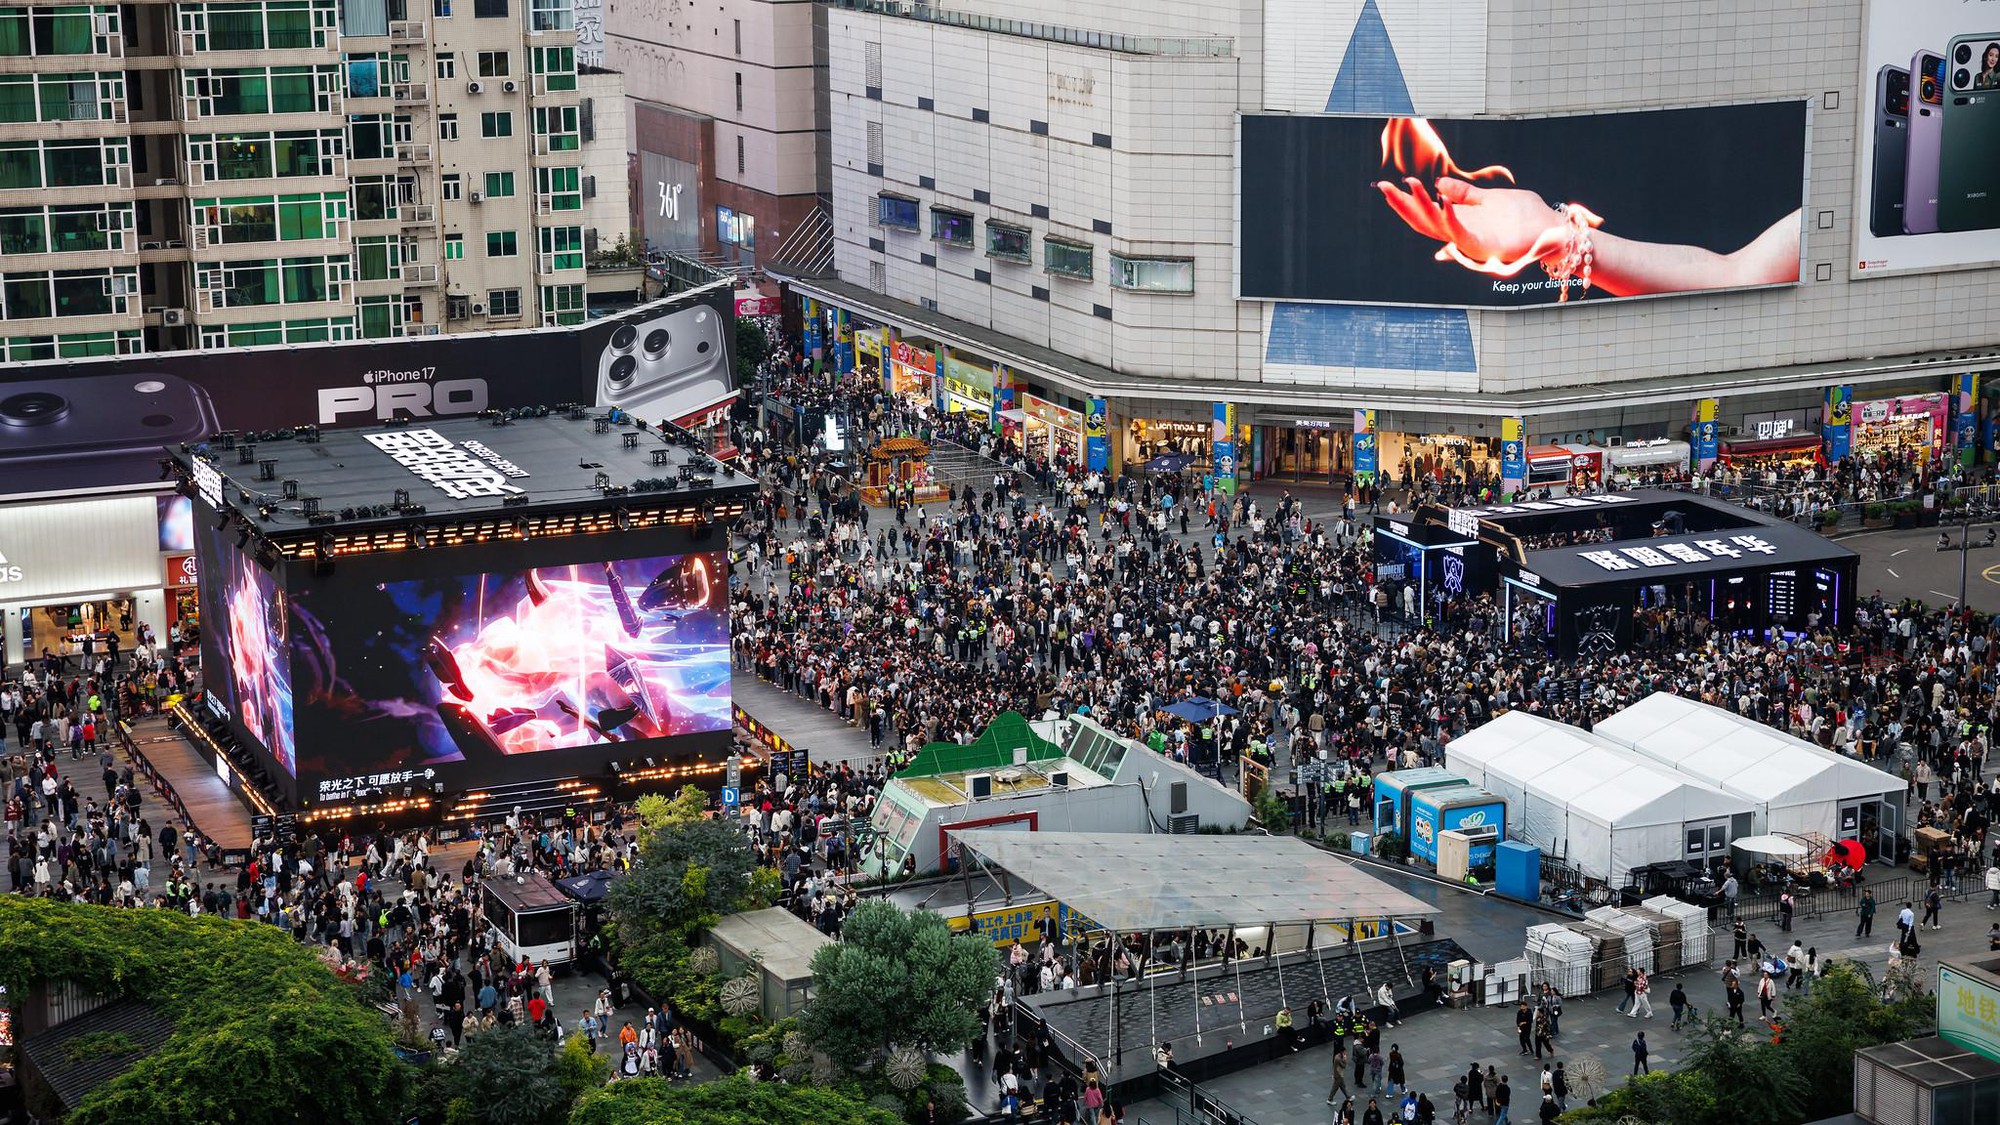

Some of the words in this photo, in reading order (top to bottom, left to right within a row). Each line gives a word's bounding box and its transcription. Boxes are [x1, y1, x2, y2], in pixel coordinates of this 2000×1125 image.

[658, 181, 682, 220] 361°
[1492, 280, 1519, 294] Keep
[1521, 280, 1543, 294] your
[374, 368, 420, 382] iPhone
[421, 366, 436, 380] 17
[317, 378, 489, 424] PRO
[706, 404, 732, 428] KFC
[1576, 534, 1777, 571] 联盟嘉年华
[319, 776, 366, 793] 荣光之下
[724, 790, 735, 803] D
[1957, 985, 1998, 1026] 地铁
